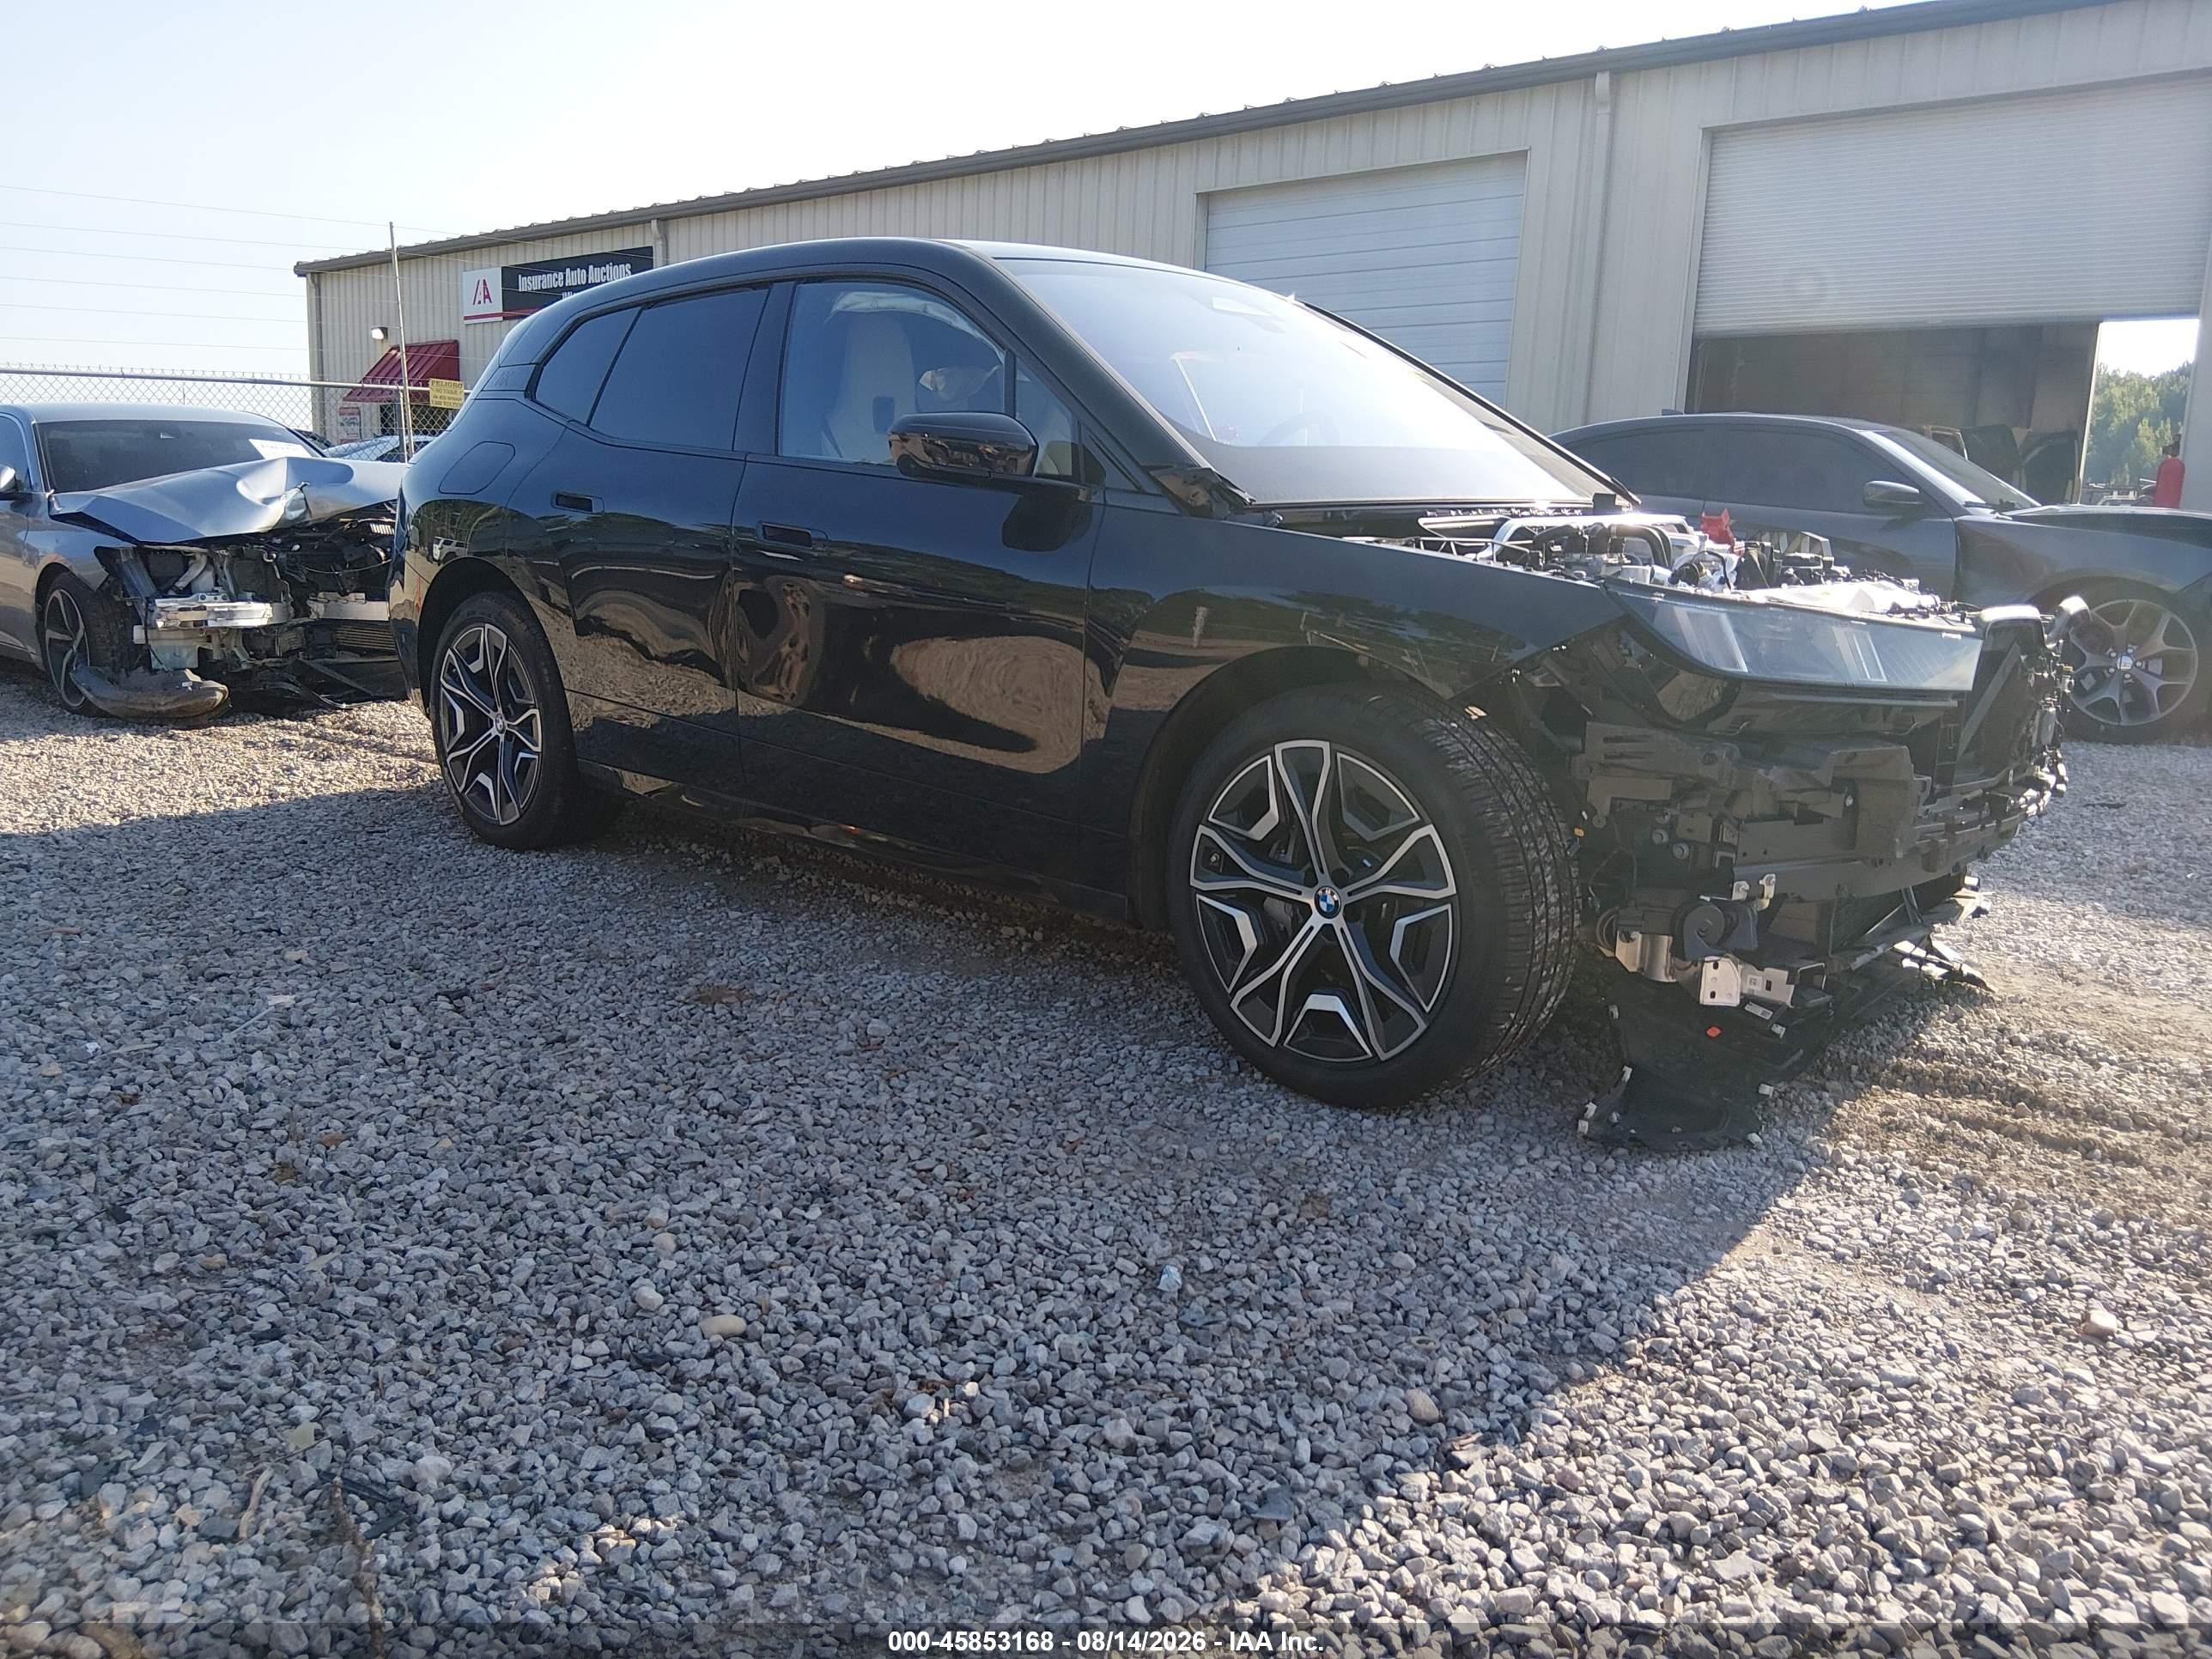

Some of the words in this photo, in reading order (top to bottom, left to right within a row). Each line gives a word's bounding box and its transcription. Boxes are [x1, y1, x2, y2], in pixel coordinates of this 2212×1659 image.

[519, 272, 564, 292] Insurance
[565, 267, 587, 287] Auto
[588, 261, 632, 284] Auctions
[431, 380, 463, 389] PELIGRO
